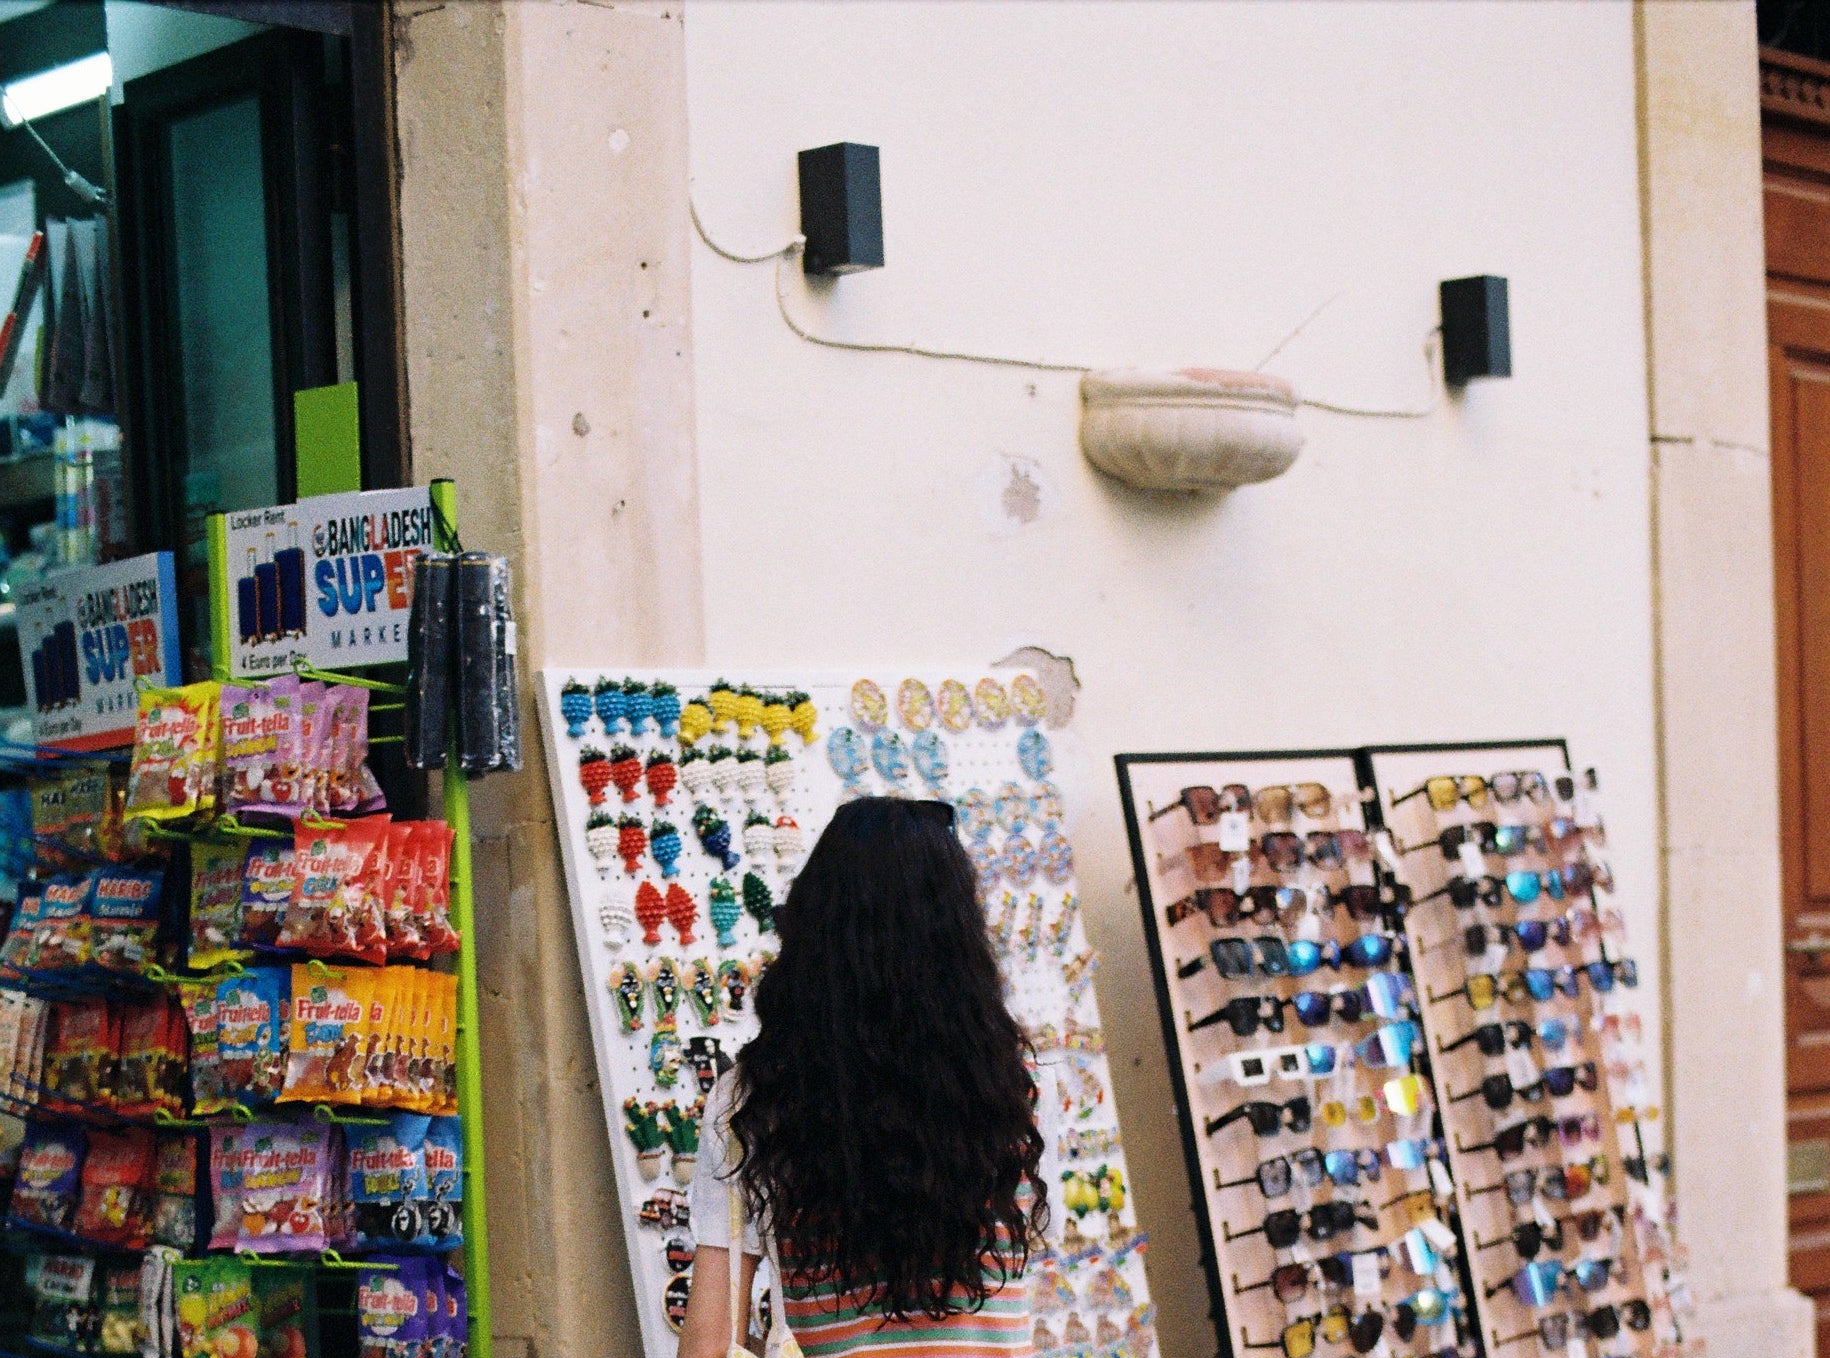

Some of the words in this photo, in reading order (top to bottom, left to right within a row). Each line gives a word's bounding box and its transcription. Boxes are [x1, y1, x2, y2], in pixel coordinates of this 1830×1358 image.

[328, 507, 431, 556] BANGLADESH
[83, 618, 161, 684] SUPER
[331, 630, 401, 649] MARKE
[222, 711, 290, 736] Fruit-tella
[297, 998, 362, 1022] Fruit-tella
